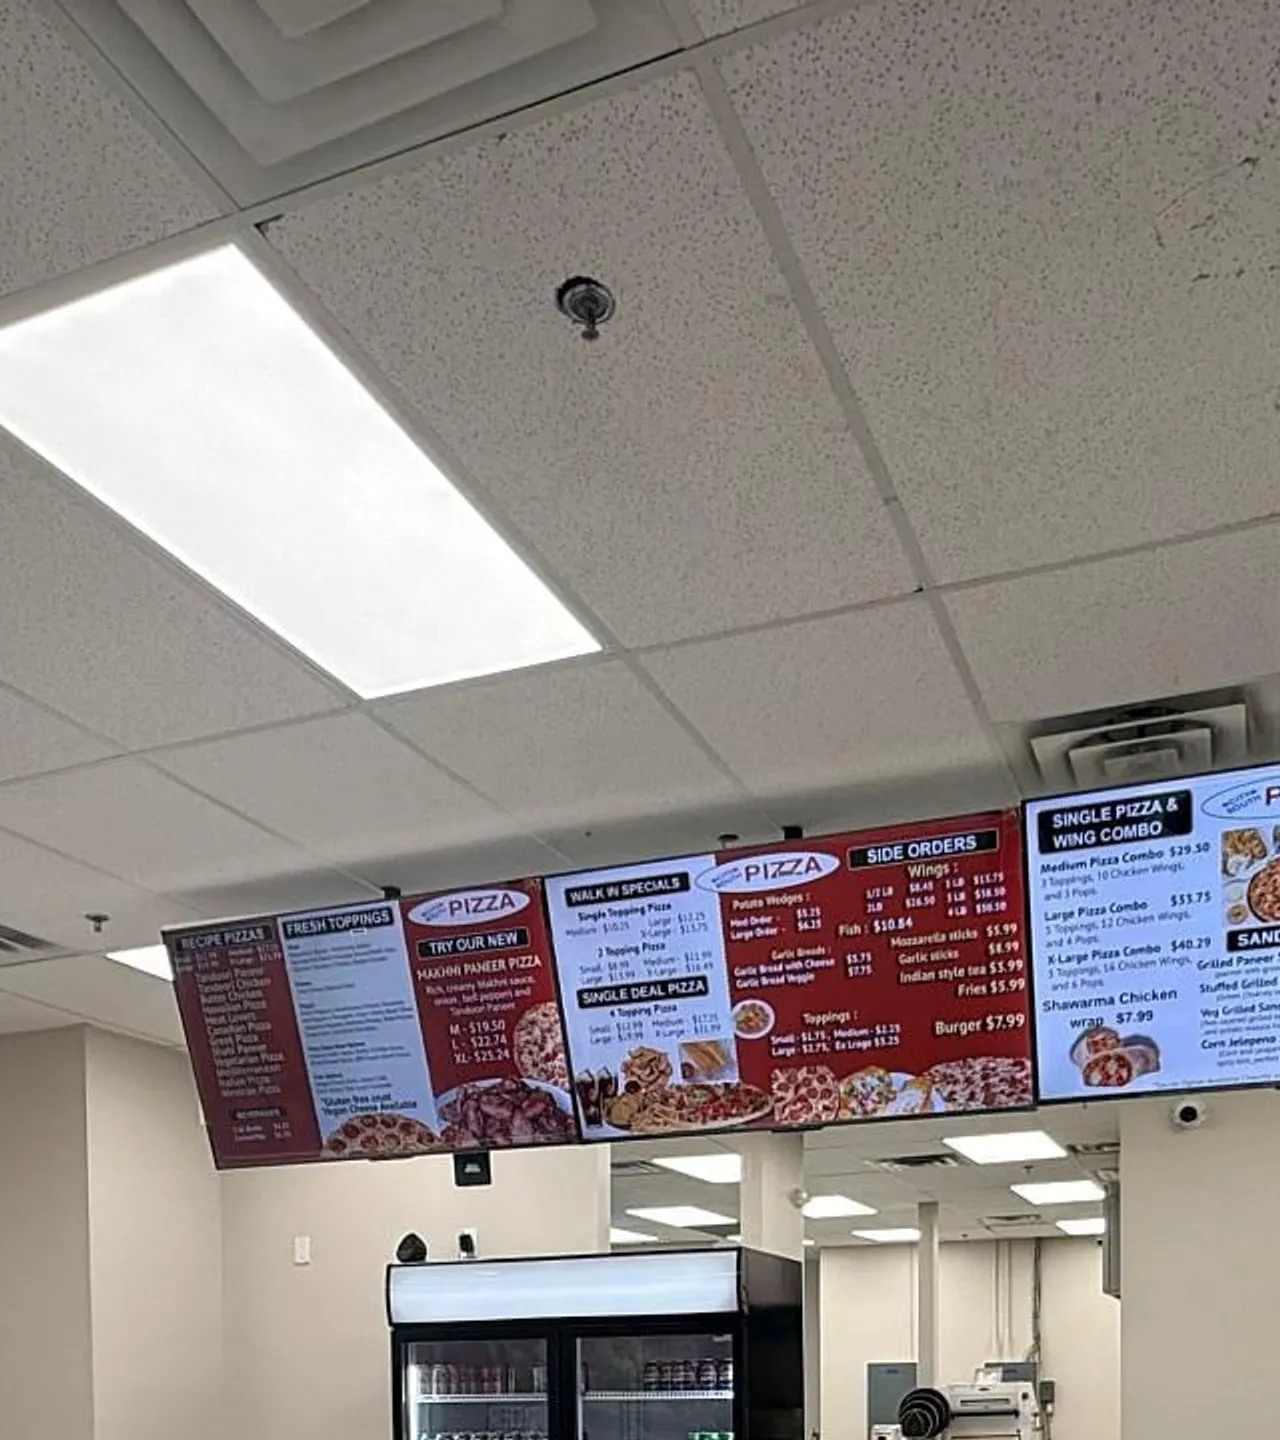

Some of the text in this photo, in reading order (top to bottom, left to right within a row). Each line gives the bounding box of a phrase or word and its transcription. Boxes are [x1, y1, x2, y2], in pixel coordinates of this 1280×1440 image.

[1052, 800, 1163, 828] SINGLE PIZZA
[1053, 821, 1163, 849] WING COMBO
[867, 835, 977, 863] SIDE ORDERS
[1122, 849, 1164, 863] Combo
[744, 856, 822, 882] PIZZA
[622, 877, 680, 895] SPECIALS
[449, 893, 516, 917] PIZZA
[286, 910, 389, 936] FRESH TOPPINGS
[429, 932, 518, 955] TRY OUR NEW
[508, 955, 542, 969] PIZZA
[582, 980, 705, 1004] SINGLE DEAL PIZZA
[1042, 989, 1177, 1012] Shawarma Chicken
[935, 1013, 1025, 1035] Burger $7.99
[1116, 1009, 1153, 1024] $7.99
